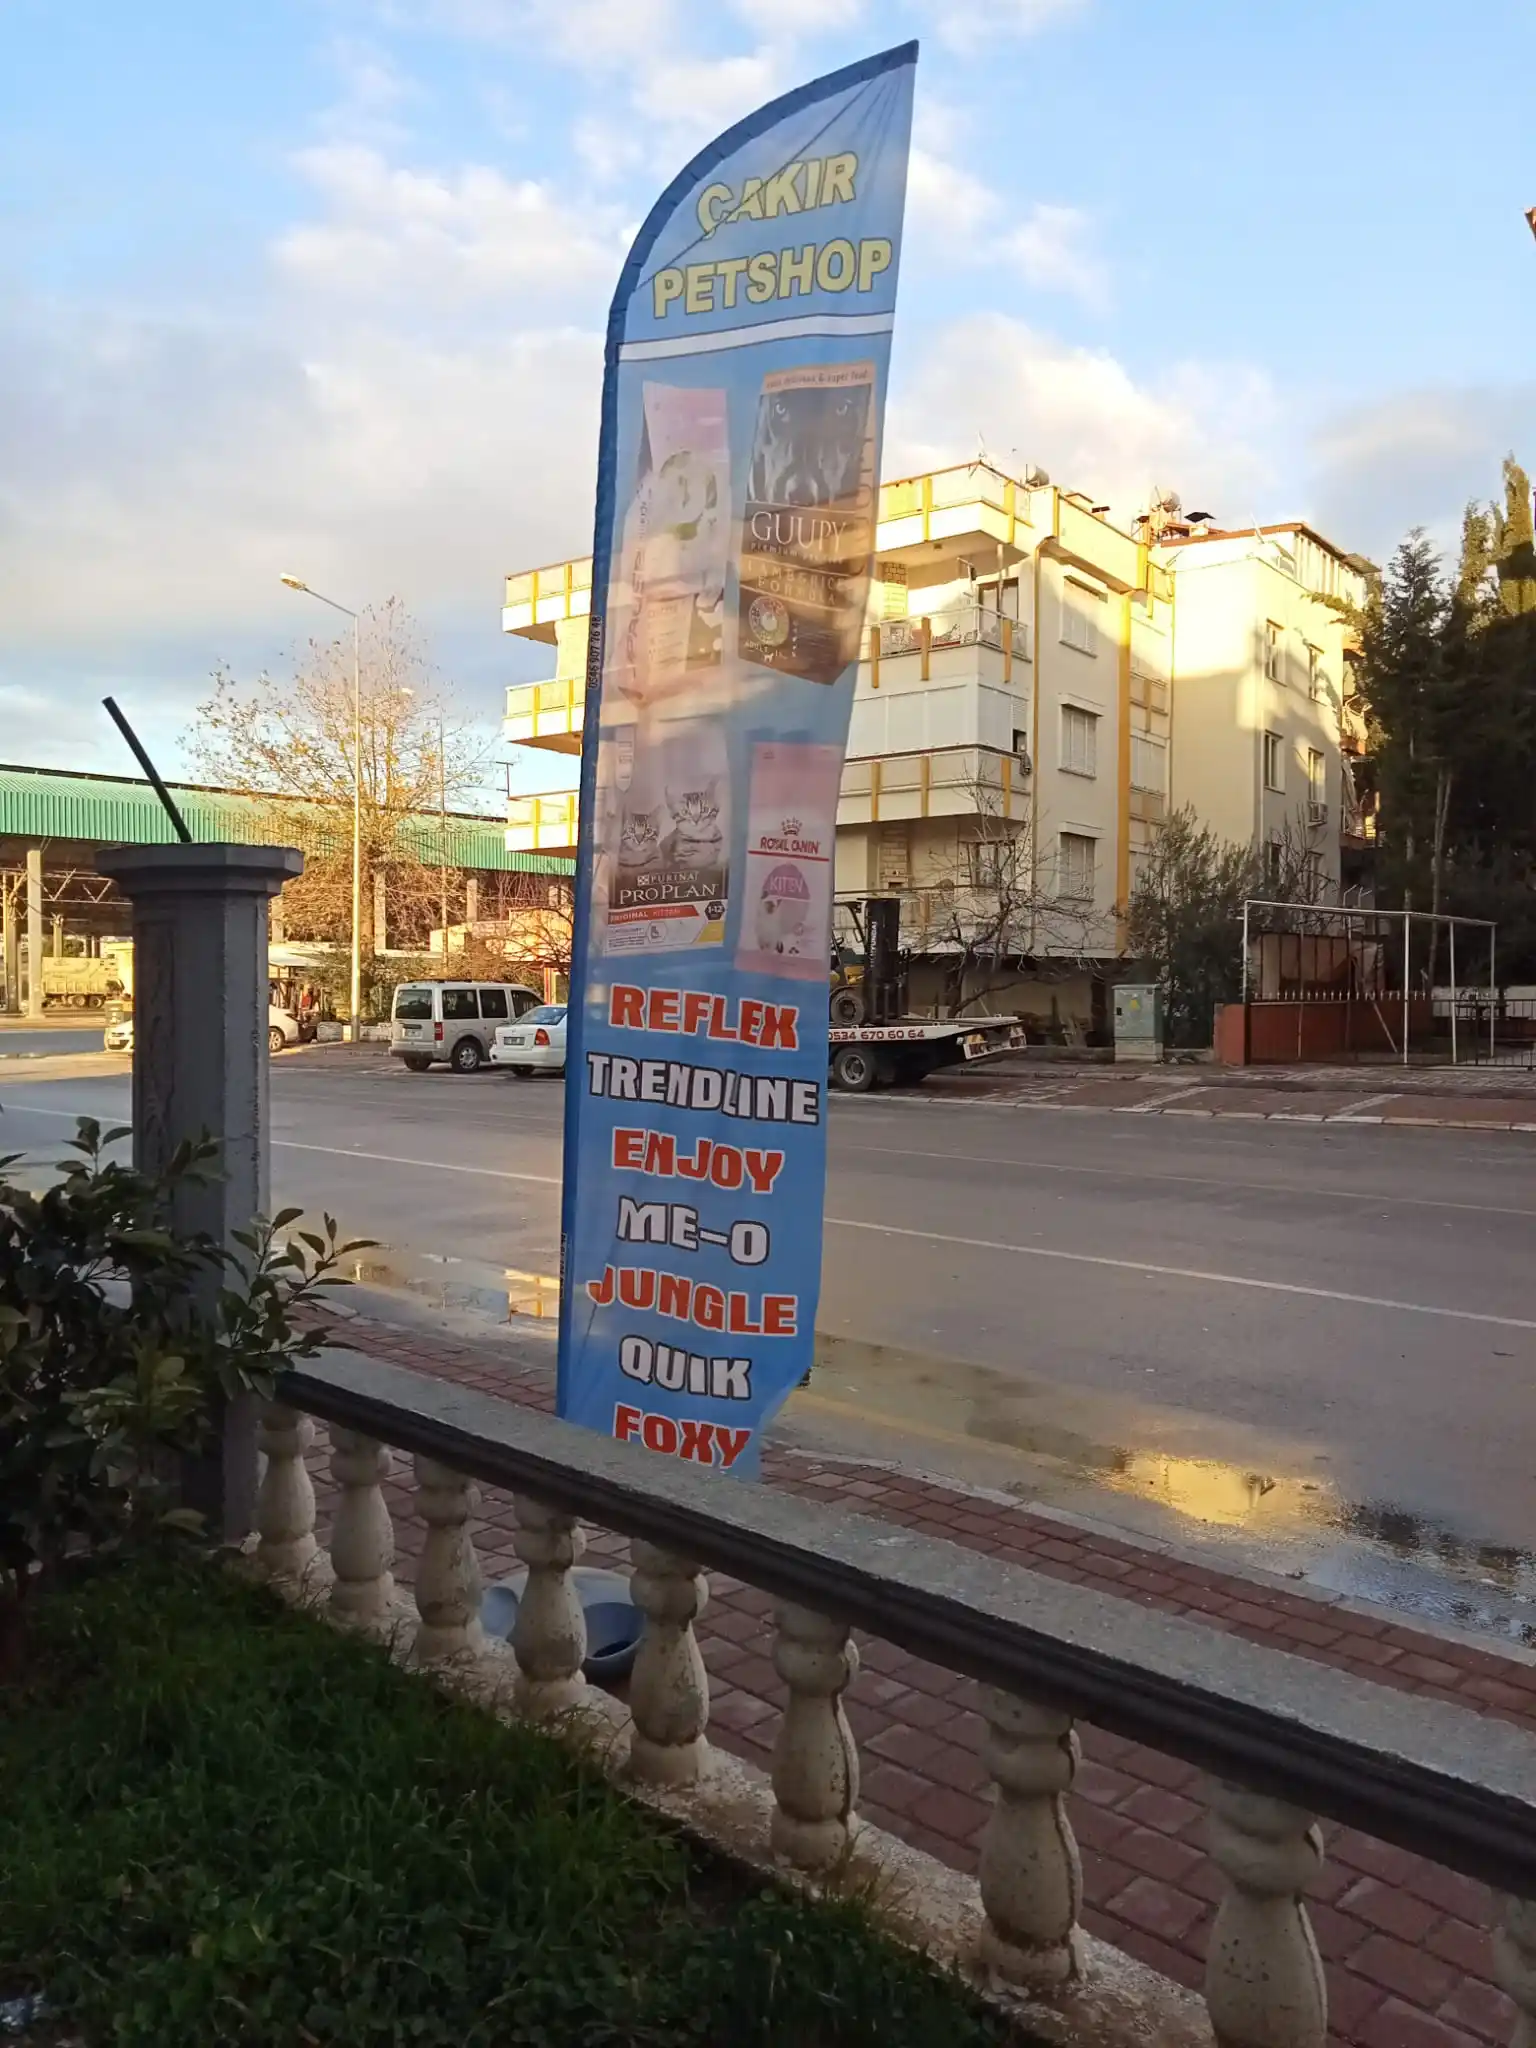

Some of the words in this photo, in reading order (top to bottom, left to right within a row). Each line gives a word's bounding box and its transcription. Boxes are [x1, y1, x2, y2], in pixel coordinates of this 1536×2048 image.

[698, 150, 859, 240] ÇAKIR
[652, 237, 893, 320] PETSHOP
[750, 510, 847, 554] GUUPY
[608, 982, 800, 1051] REFLEX
[860, 1030, 885, 1040] 670
[887, 1030, 905, 1039] 60
[908, 1028, 925, 1038] 64
[586, 1051, 820, 1125] TRENDLINE
[611, 1126, 786, 1194] ENJOY
[616, 1194, 770, 1265] ME-O
[585, 1263, 798, 1336] JUNGLE
[618, 1334, 752, 1401] QUIK
[612, 1401, 753, 1469] FOXY
